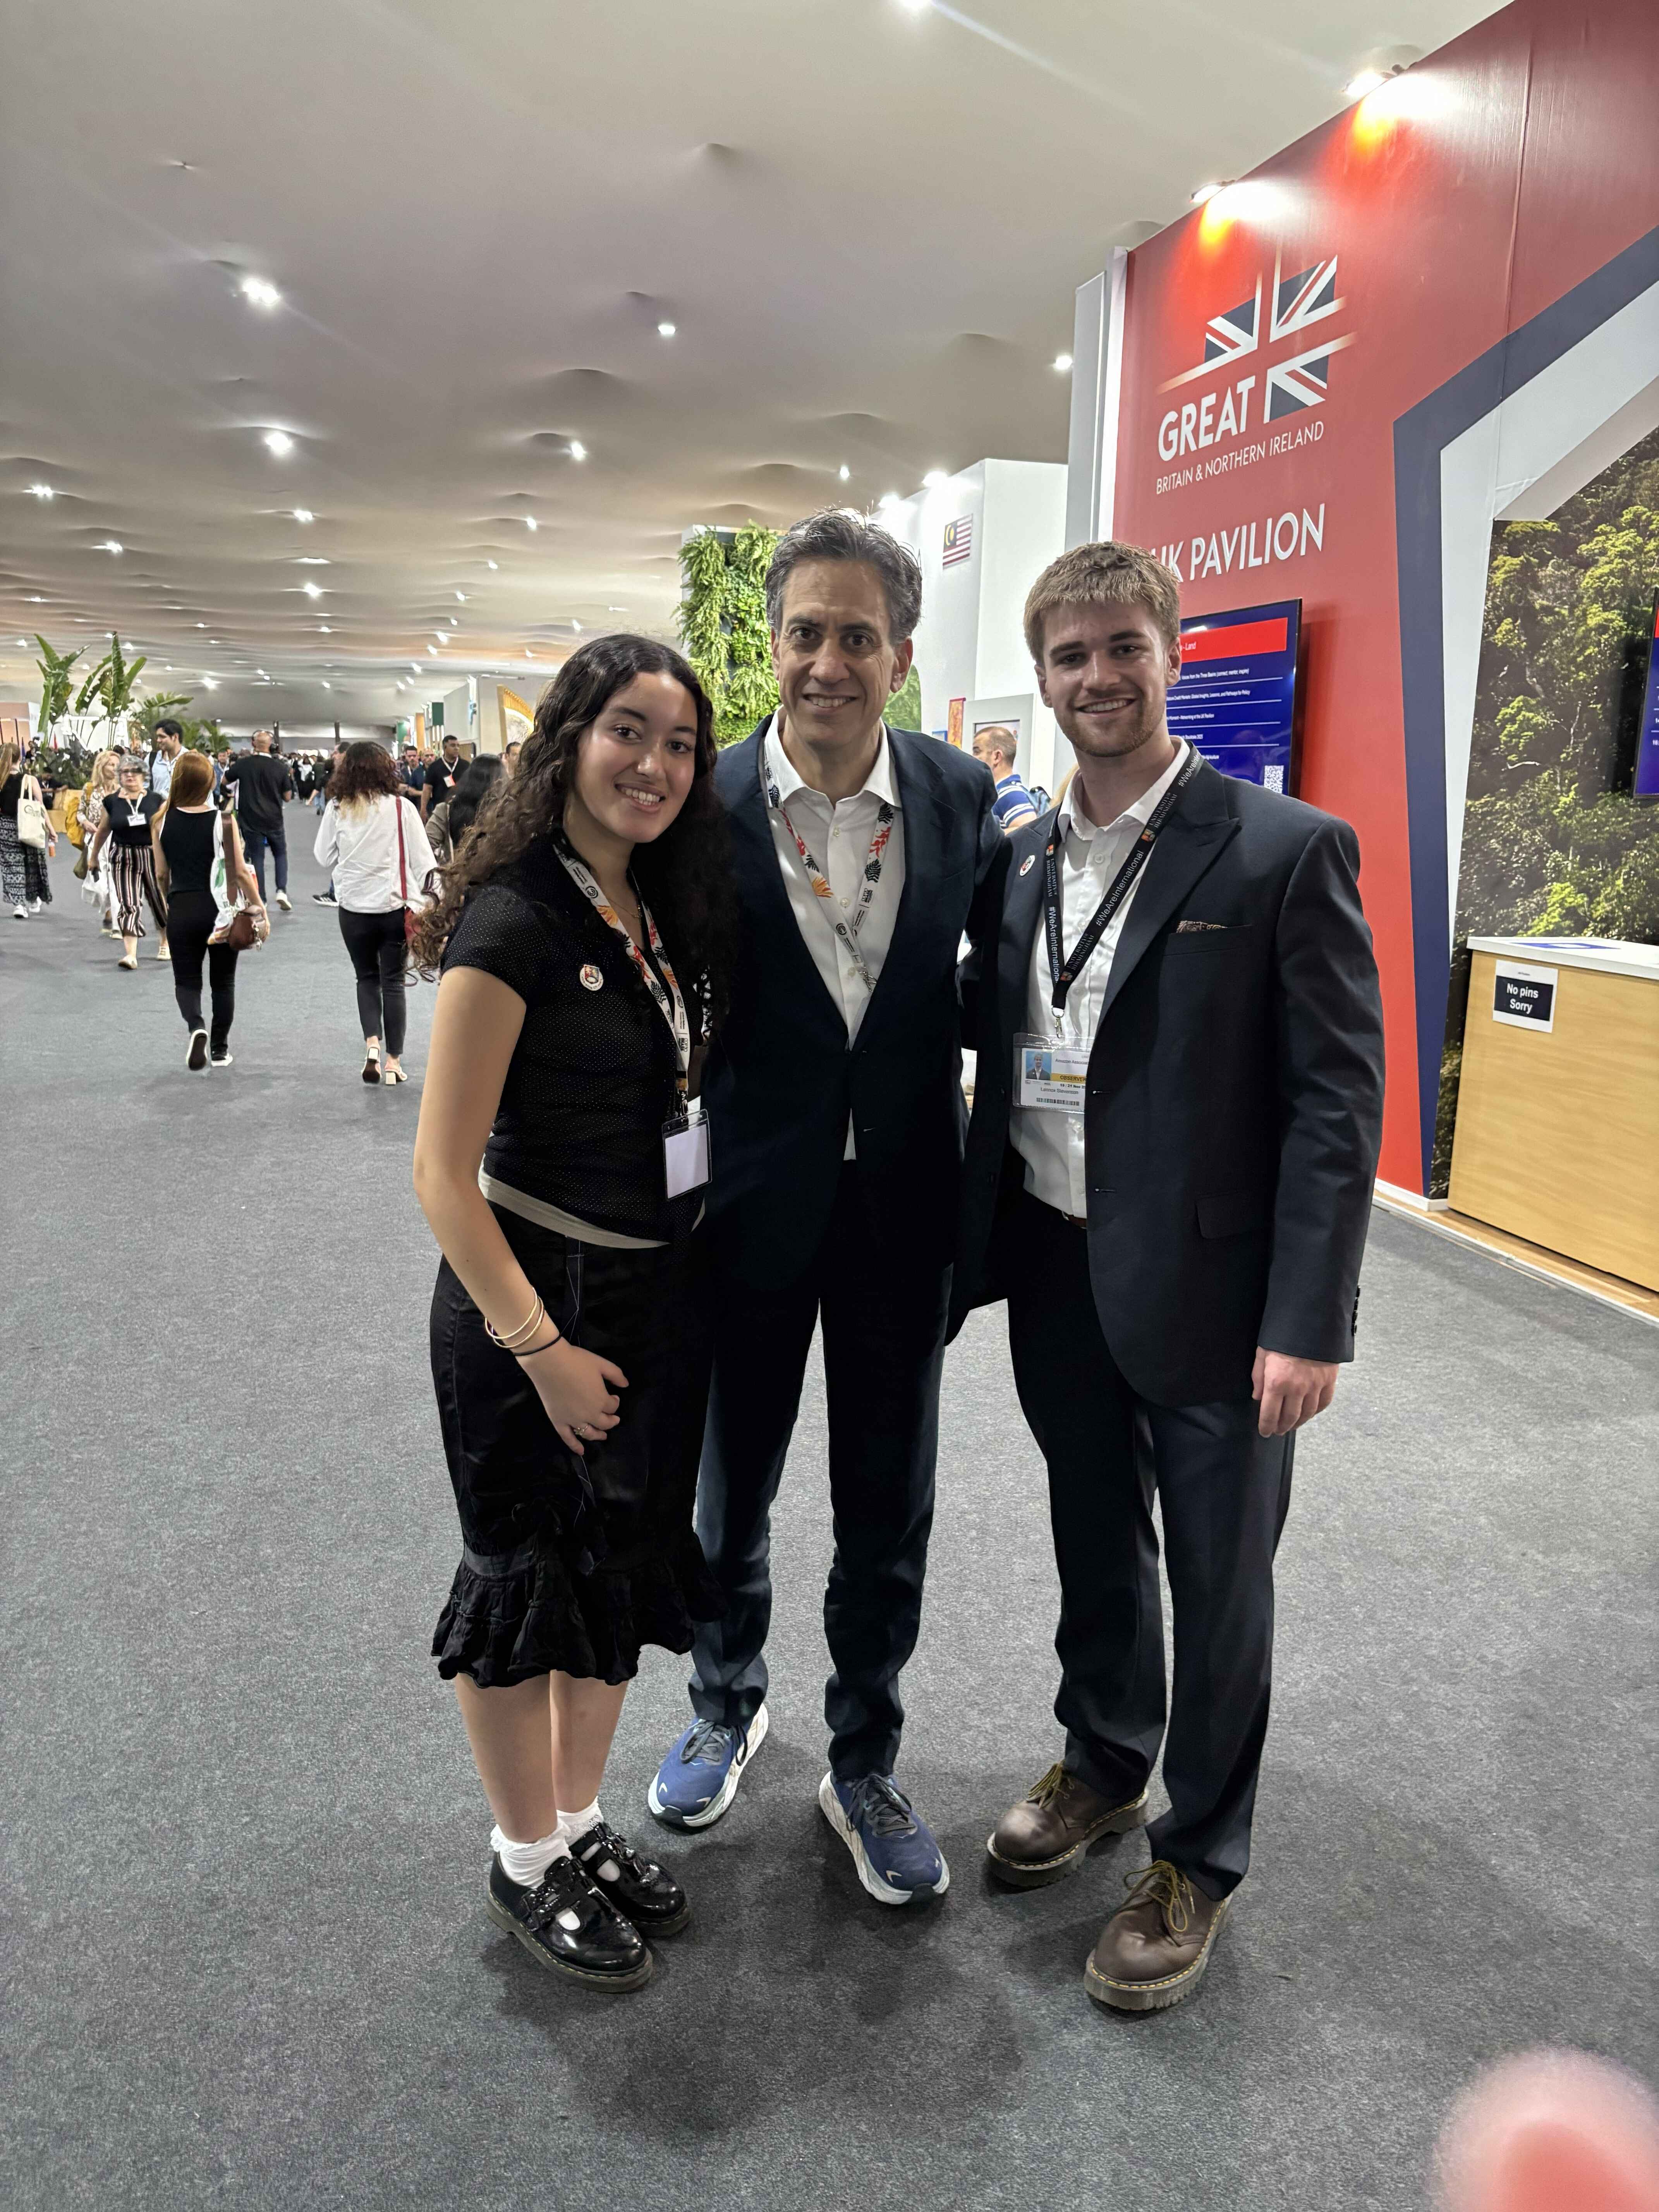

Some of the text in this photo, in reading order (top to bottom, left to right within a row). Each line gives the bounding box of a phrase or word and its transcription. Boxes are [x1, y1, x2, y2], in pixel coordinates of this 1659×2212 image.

[1158, 375, 1255, 461] GREAT
[1156, 421, 1324, 495] BRITAIN & NORTHERN IRELAND
[1190, 503, 1325, 580] PAVILION
[1096, 850, 1144, 926] #WeAreInternational
[1049, 906, 1060, 983] #WeAreInternationa
[1507, 983, 1539, 998] No pins
[1510, 998, 1532, 1014] Sorry
